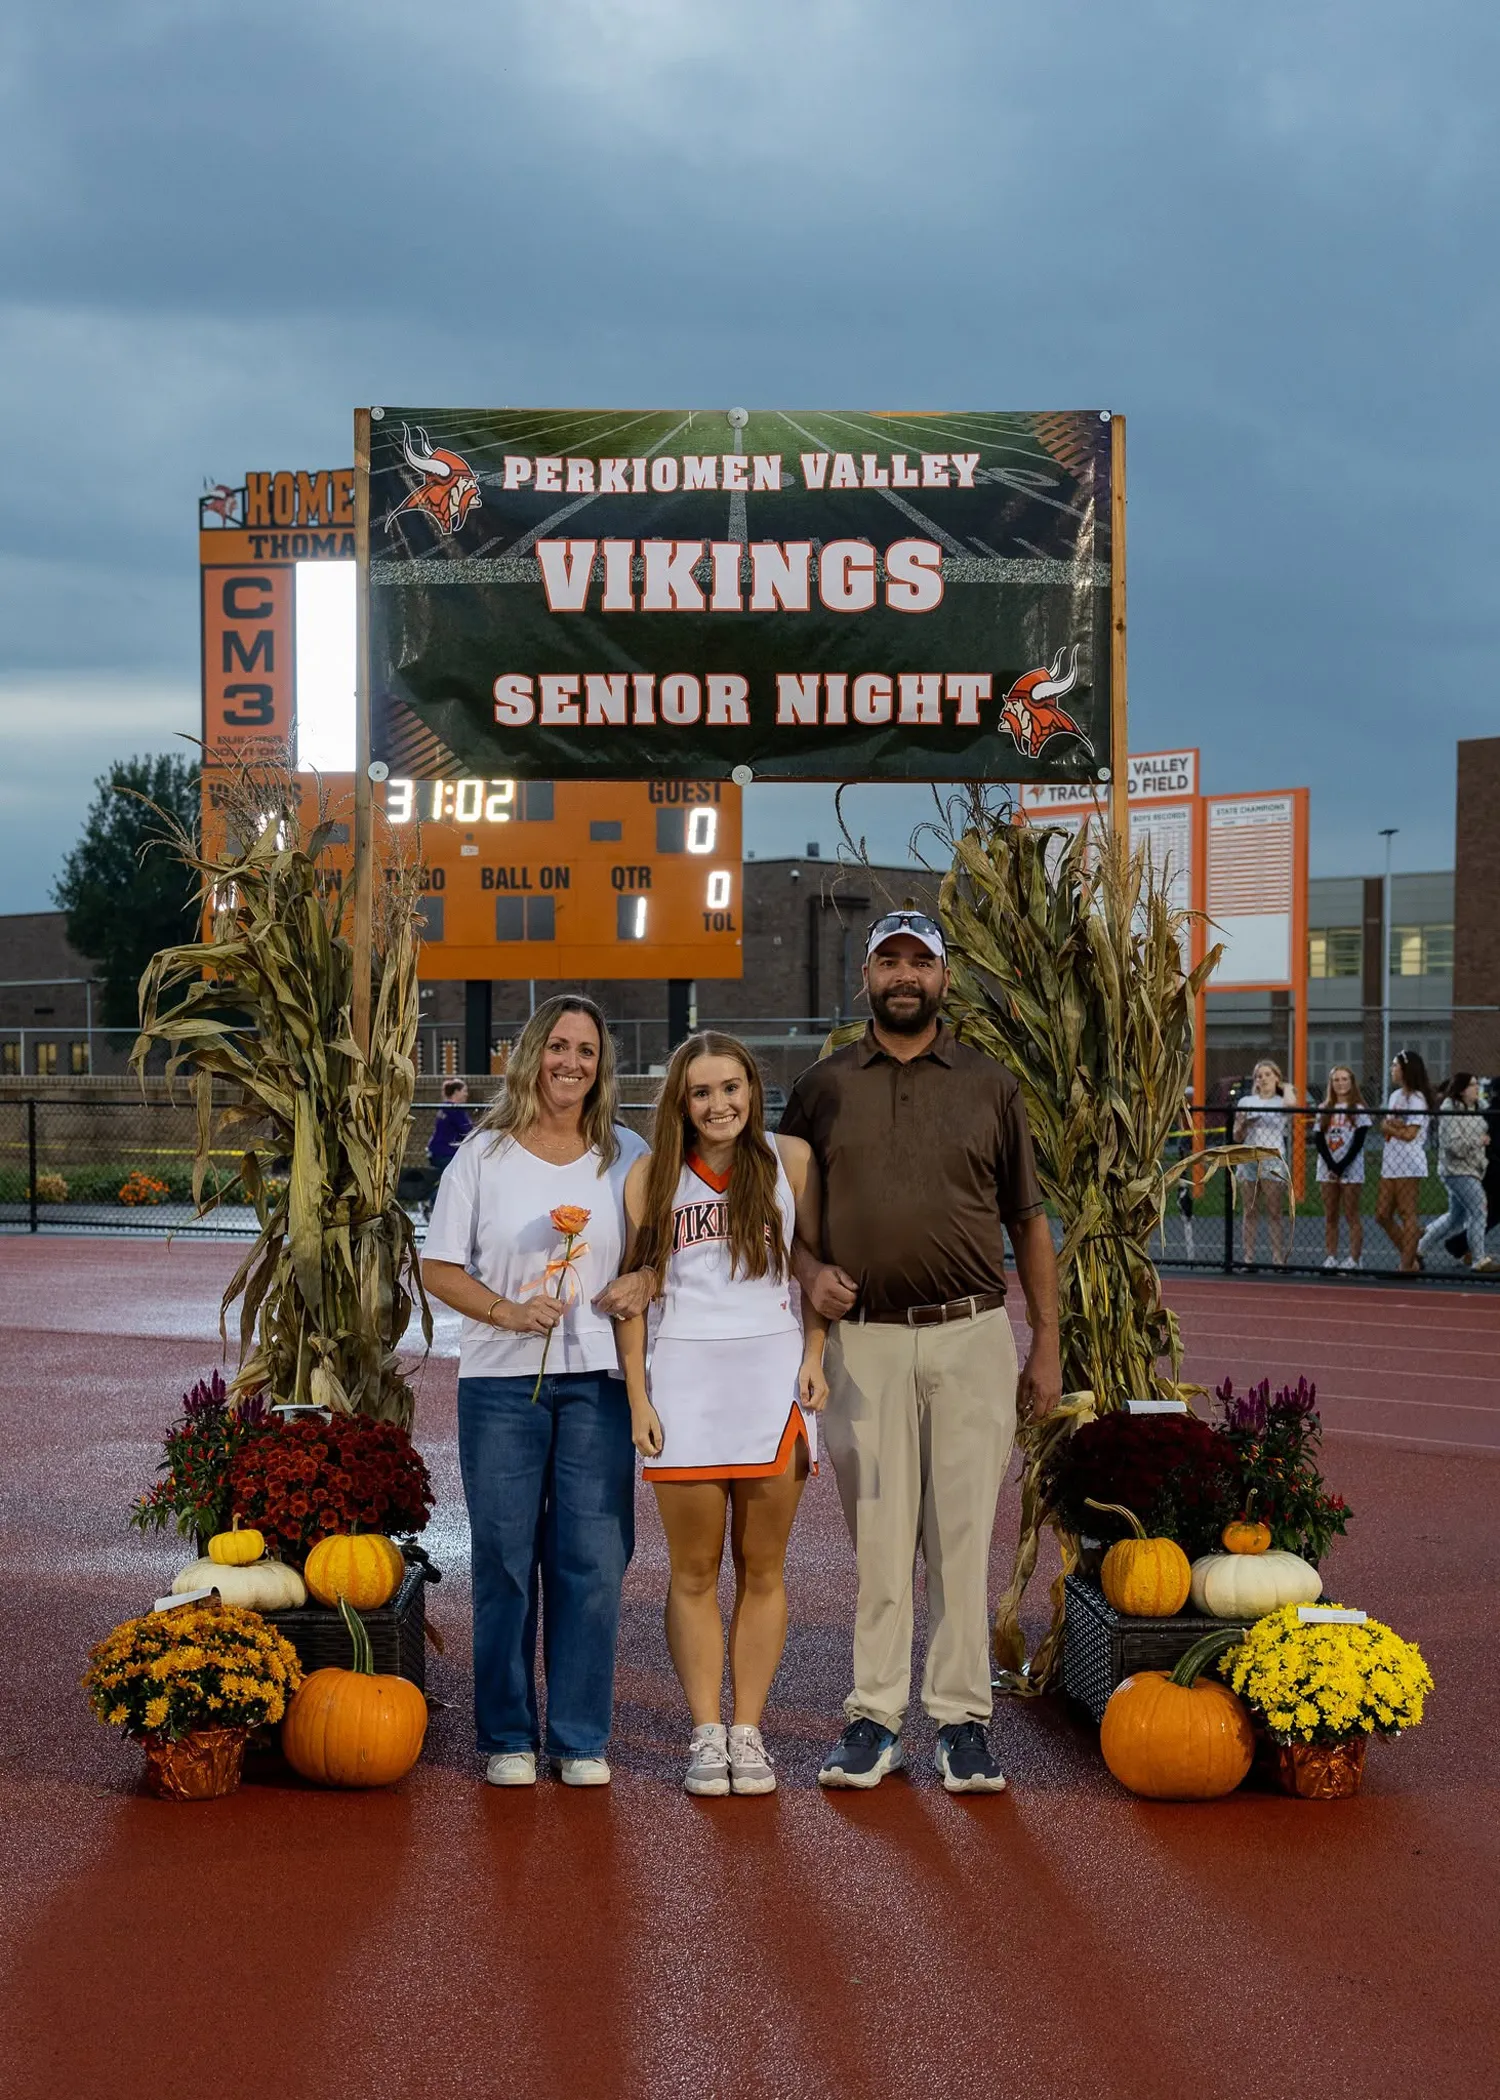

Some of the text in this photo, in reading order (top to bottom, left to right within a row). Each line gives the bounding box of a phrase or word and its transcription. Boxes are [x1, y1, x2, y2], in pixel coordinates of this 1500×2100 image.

[502, 452, 981, 493] PERKIOMEN VALLEY
[246, 469, 354, 527] HOME
[535, 538, 945, 613] VIKINGS
[493, 672, 993, 727] SENIOR NIGHT
[1133, 757, 1188, 775] VALLEY
[386, 779, 514, 823] 31:02
[648, 781, 721, 804] GUEST
[1049, 784, 1099, 801] TRACK
[1143, 774, 1188, 793] FIELD
[687, 807, 717, 854] 0
[481, 866, 570, 890] BALL ON
[611, 866, 652, 890] QTR
[706, 870, 731, 909] 0
[635, 896, 647, 938] 1
[702, 912, 737, 931] TOL
